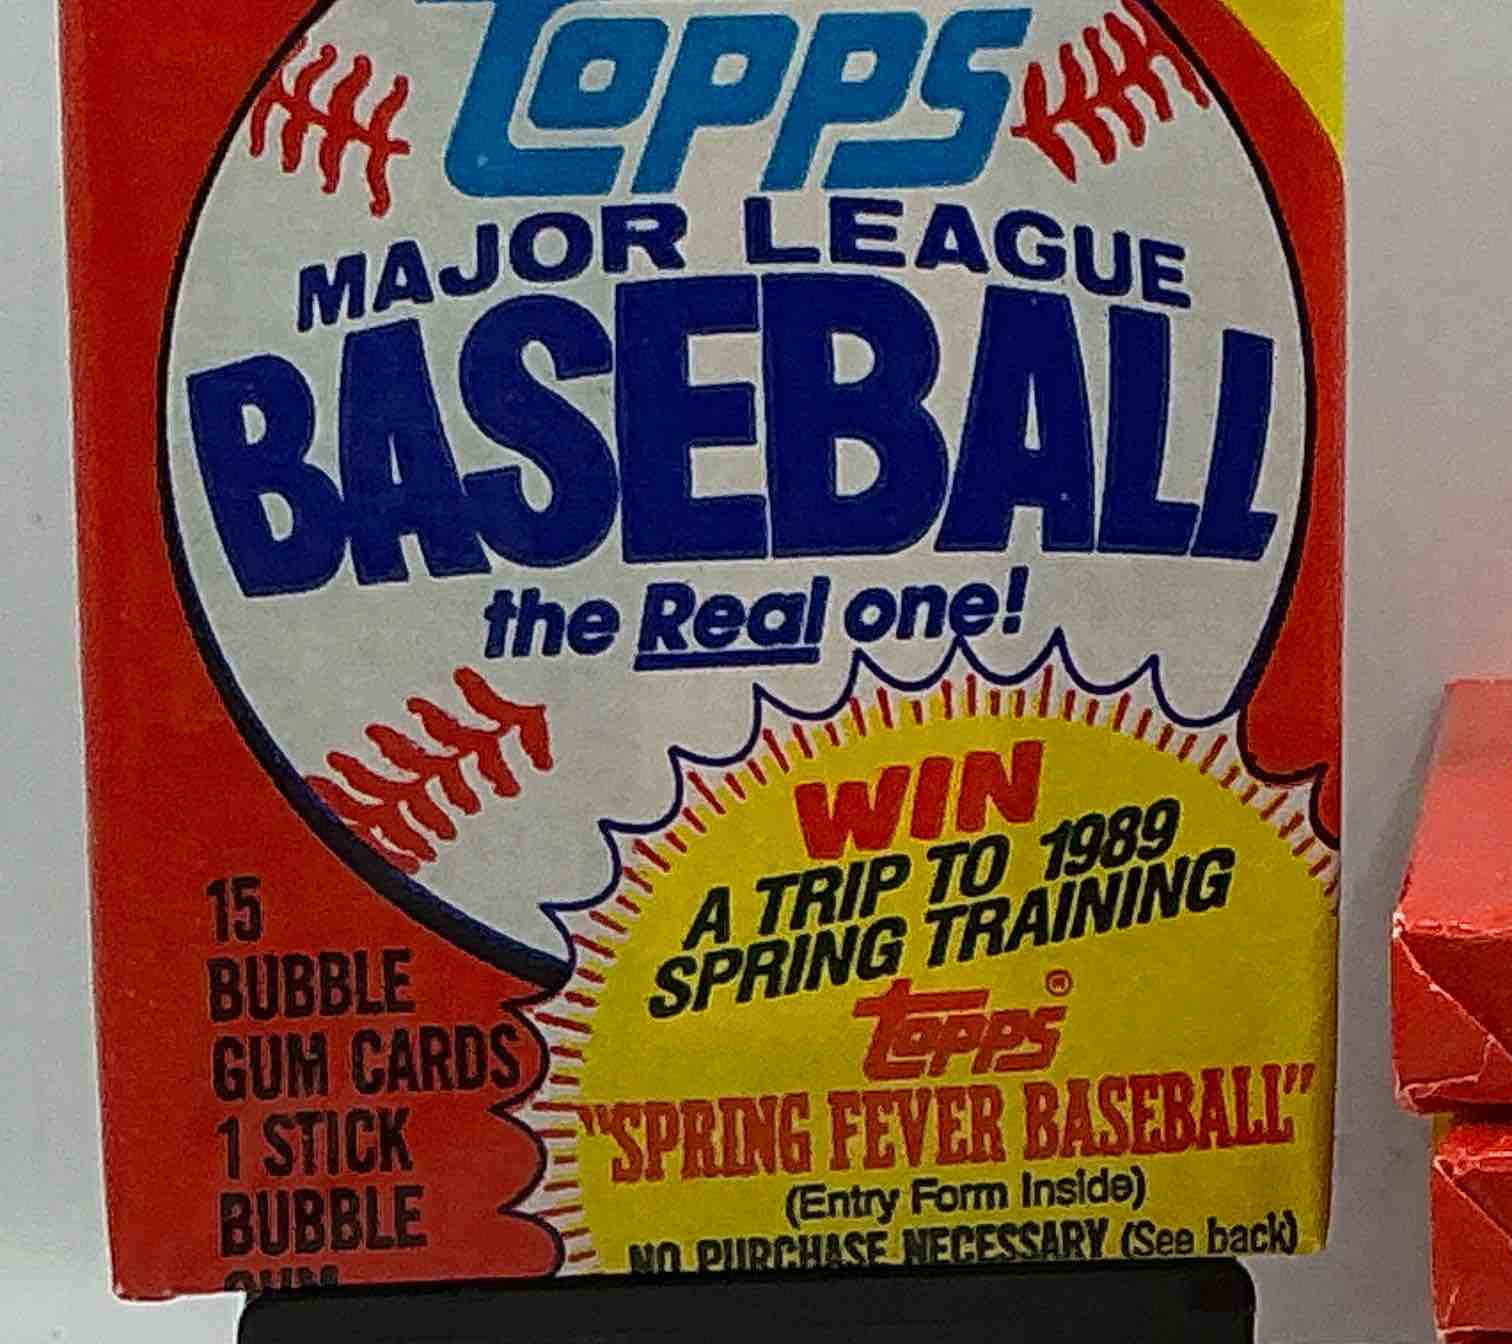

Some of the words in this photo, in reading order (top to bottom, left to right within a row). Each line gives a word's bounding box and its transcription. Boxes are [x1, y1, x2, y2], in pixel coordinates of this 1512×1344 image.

[297, 199, 688, 331] MAJOR
[746, 196, 1193, 310] LEAGUE
[187, 272, 1279, 598] BASEBALL
[484, 587, 620, 658] the
[637, 575, 831, 660] Real
[844, 565, 1029, 644] one!
[794, 739, 1045, 860] WIN
[206, 875, 264, 944] 15
[684, 886, 732, 951] A
[757, 853, 912, 937] TRIP
[925, 834, 1010, 906] TO
[1039, 797, 1181, 881] 1989
[647, 916, 911, 1020] SPRING
[924, 846, 1236, 968] TRAINING
[206, 947, 416, 1023] BUBBLE
[211, 1030, 329, 1103] GUM
[350, 1022, 522, 1095] CARDS
[216, 1115, 241, 1180] 1
[262, 1107, 414, 1177] STICK
[827, 1083, 1007, 1172] FEVER
[218, 1184, 428, 1256] BUBBLE
[784, 1181, 901, 1229] (Entry
[911, 1176, 1009, 1215] Form
[1021, 1164, 1147, 1210] Inside)
[627, 1241, 682, 1274] NO
[696, 1229, 890, 1273] PURCHASE
[902, 1215, 1110, 1265] NECESSARY
[1120, 1218, 1196, 1258] (See
[1206, 1208, 1299, 1256] back)
